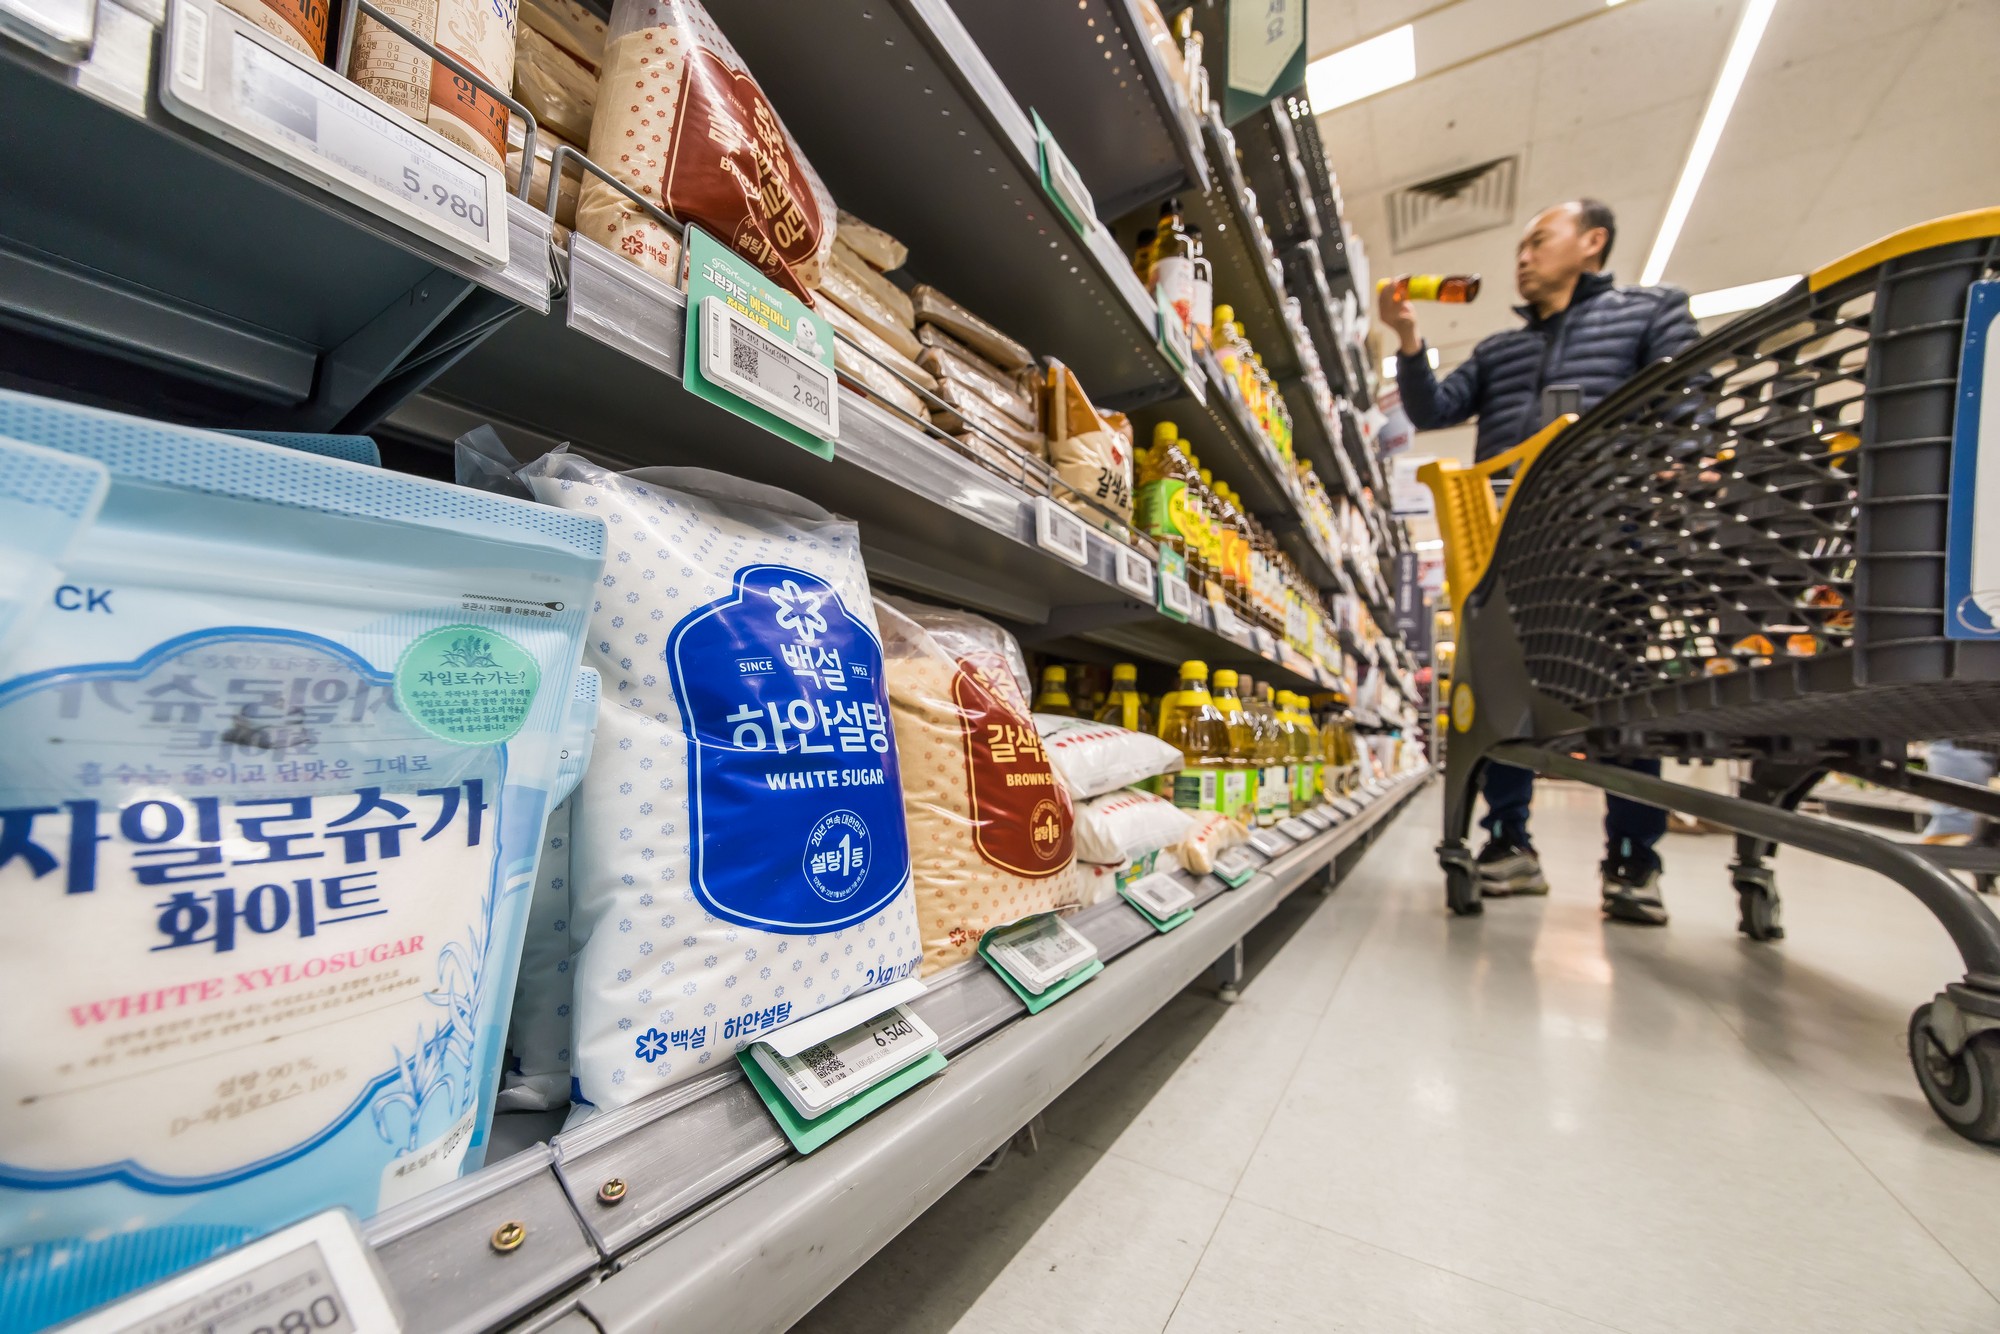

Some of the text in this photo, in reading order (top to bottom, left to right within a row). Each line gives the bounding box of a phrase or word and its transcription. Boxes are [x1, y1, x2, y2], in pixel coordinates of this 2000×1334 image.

[417, 12, 423, 20] 2
[386, 50, 392, 58] 0
[387, 42, 393, 50] 0
[411, 66, 418, 75] 0
[413, 57, 419, 65] 0
[411, 75, 417, 84] 0
[702, 262, 749, 305] 그린카드
[749, 294, 791, 333] 에코머니
[53, 584, 113, 614] CK
[461, 602, 552, 618] 보관시 지퍼를 이용하세요
[739, 660, 774, 674] SINCE
[780, 644, 848, 692] 백설
[851, 665, 868, 678] 1953
[418, 670, 527, 687] 자일로슈가는?
[726, 699, 890, 755] 하얀설탕
[277, 759, 354, 783] 단맛은
[363, 754, 432, 775] 그대로
[765, 768, 885, 791] WHITE SUGAR
[1005, 772, 1047, 787] BROWN
[0, 778, 488, 895] 자일로슈가
[841, 813, 866, 840] 대한민국
[810, 833, 864, 877] 설탕1등
[149, 868, 389, 954] 화이트
[67, 979, 226, 1031] WHITE
[232, 934, 426, 995] XYLOSUGAR
[671, 1000, 794, 1050] 백설 하얀설탕
[266, 1062, 293, 1084] 90
[309, 1073, 329, 1092] 10
